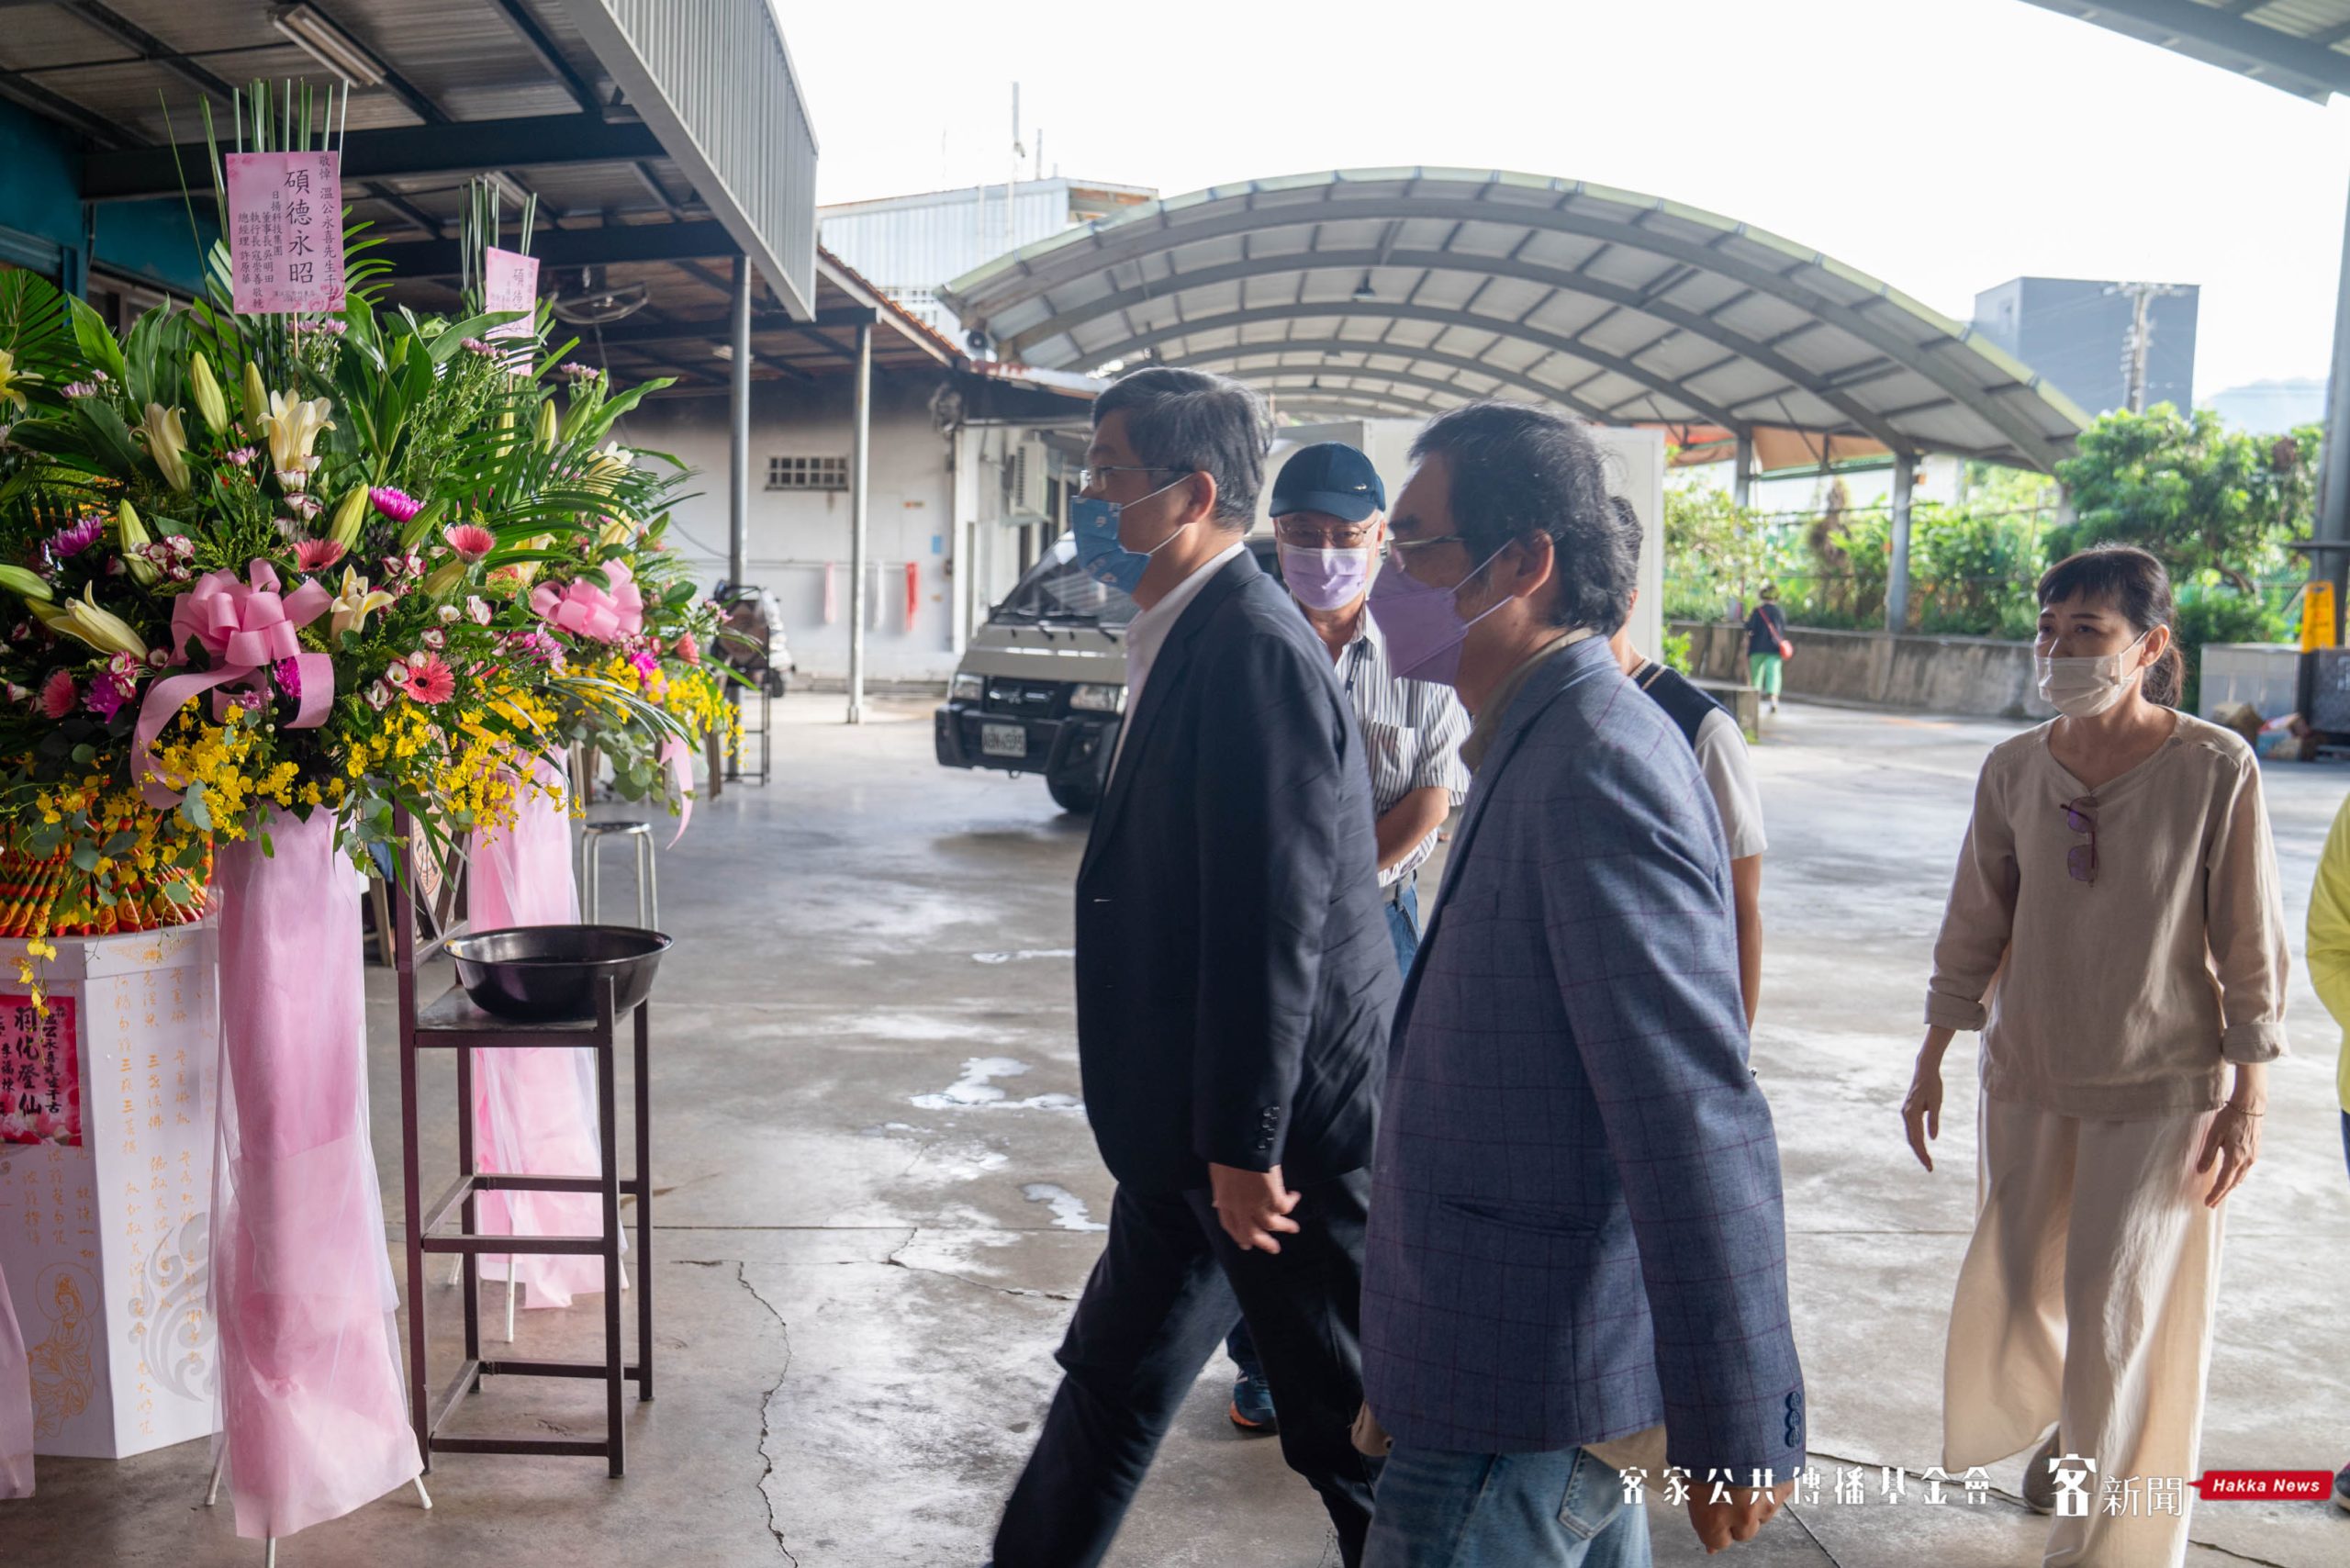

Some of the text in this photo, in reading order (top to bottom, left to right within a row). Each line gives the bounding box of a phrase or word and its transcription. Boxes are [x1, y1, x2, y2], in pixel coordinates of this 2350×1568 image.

[284, 169, 315, 285] 碩德永昭
[15, 1006, 42, 1117] 羽化登仙
